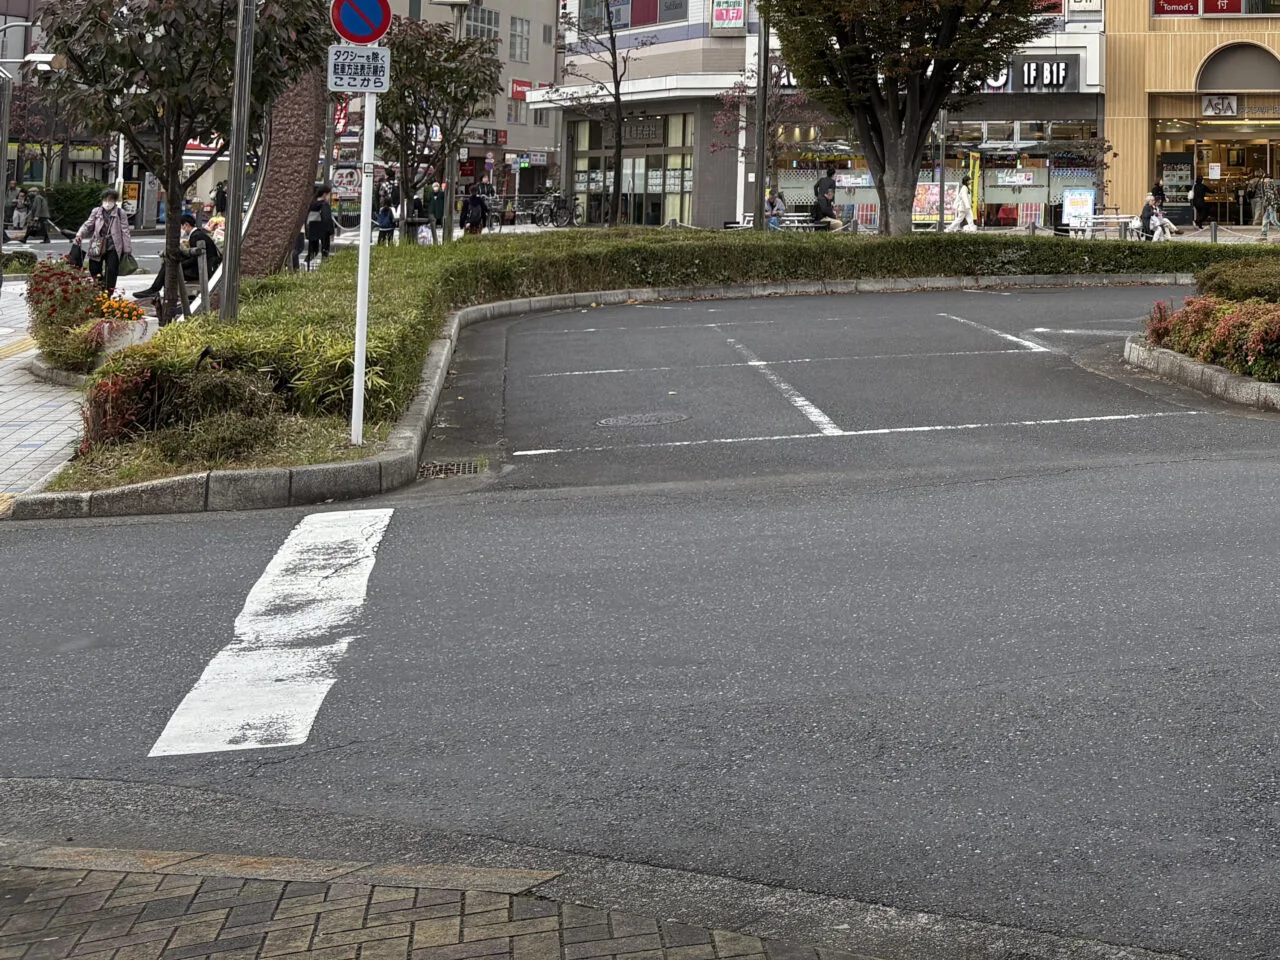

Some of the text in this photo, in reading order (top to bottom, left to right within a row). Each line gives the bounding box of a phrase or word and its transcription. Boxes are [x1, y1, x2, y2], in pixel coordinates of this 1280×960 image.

[1163, 2, 1194, 11] Tomod's
[721, 10, 738, 19] 1F
[334, 50, 385, 63] タクシーを除く
[1023, 62, 1066, 85] 1F B1F
[334, 76, 384, 88] ここから
[1204, 96, 1235, 115] ASTA
